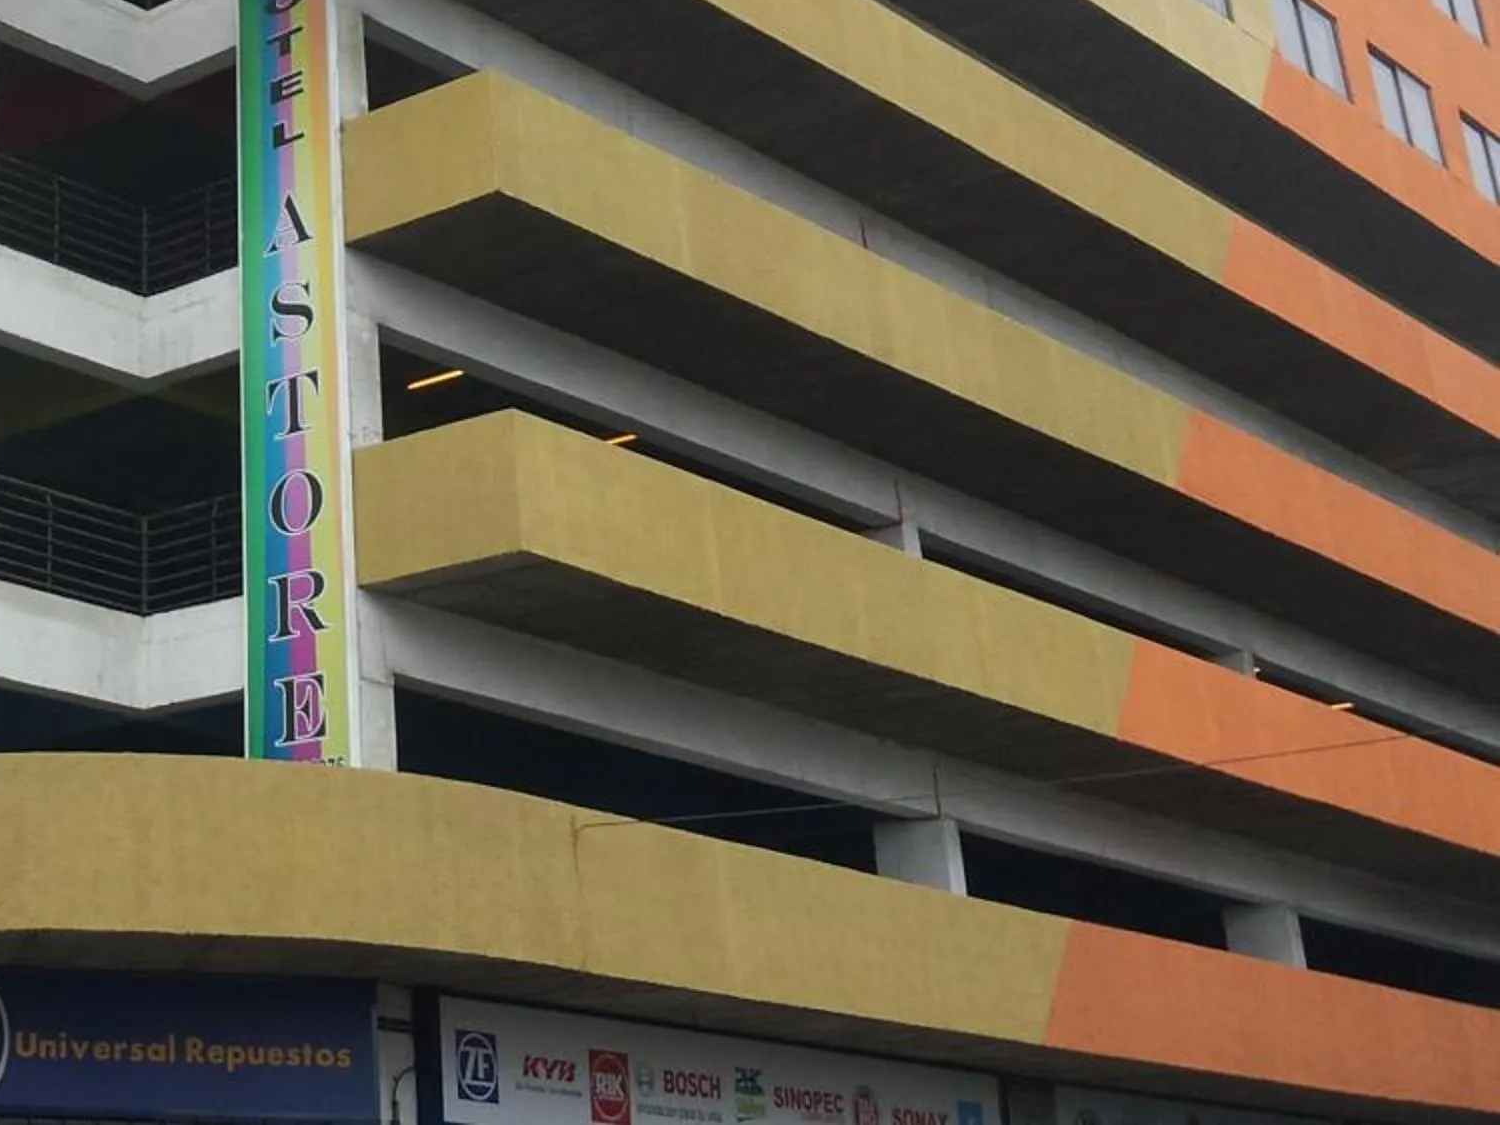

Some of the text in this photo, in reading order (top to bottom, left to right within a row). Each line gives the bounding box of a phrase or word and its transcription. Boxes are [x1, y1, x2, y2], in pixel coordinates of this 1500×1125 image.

[263, 193, 331, 748] ASTORE
[15, 1029, 353, 1074] Universal Repuestos
[522, 1054, 577, 1083] KYB
[662, 1069, 722, 1100] BOSCH
[773, 1085, 844, 1114] SINOPEC
